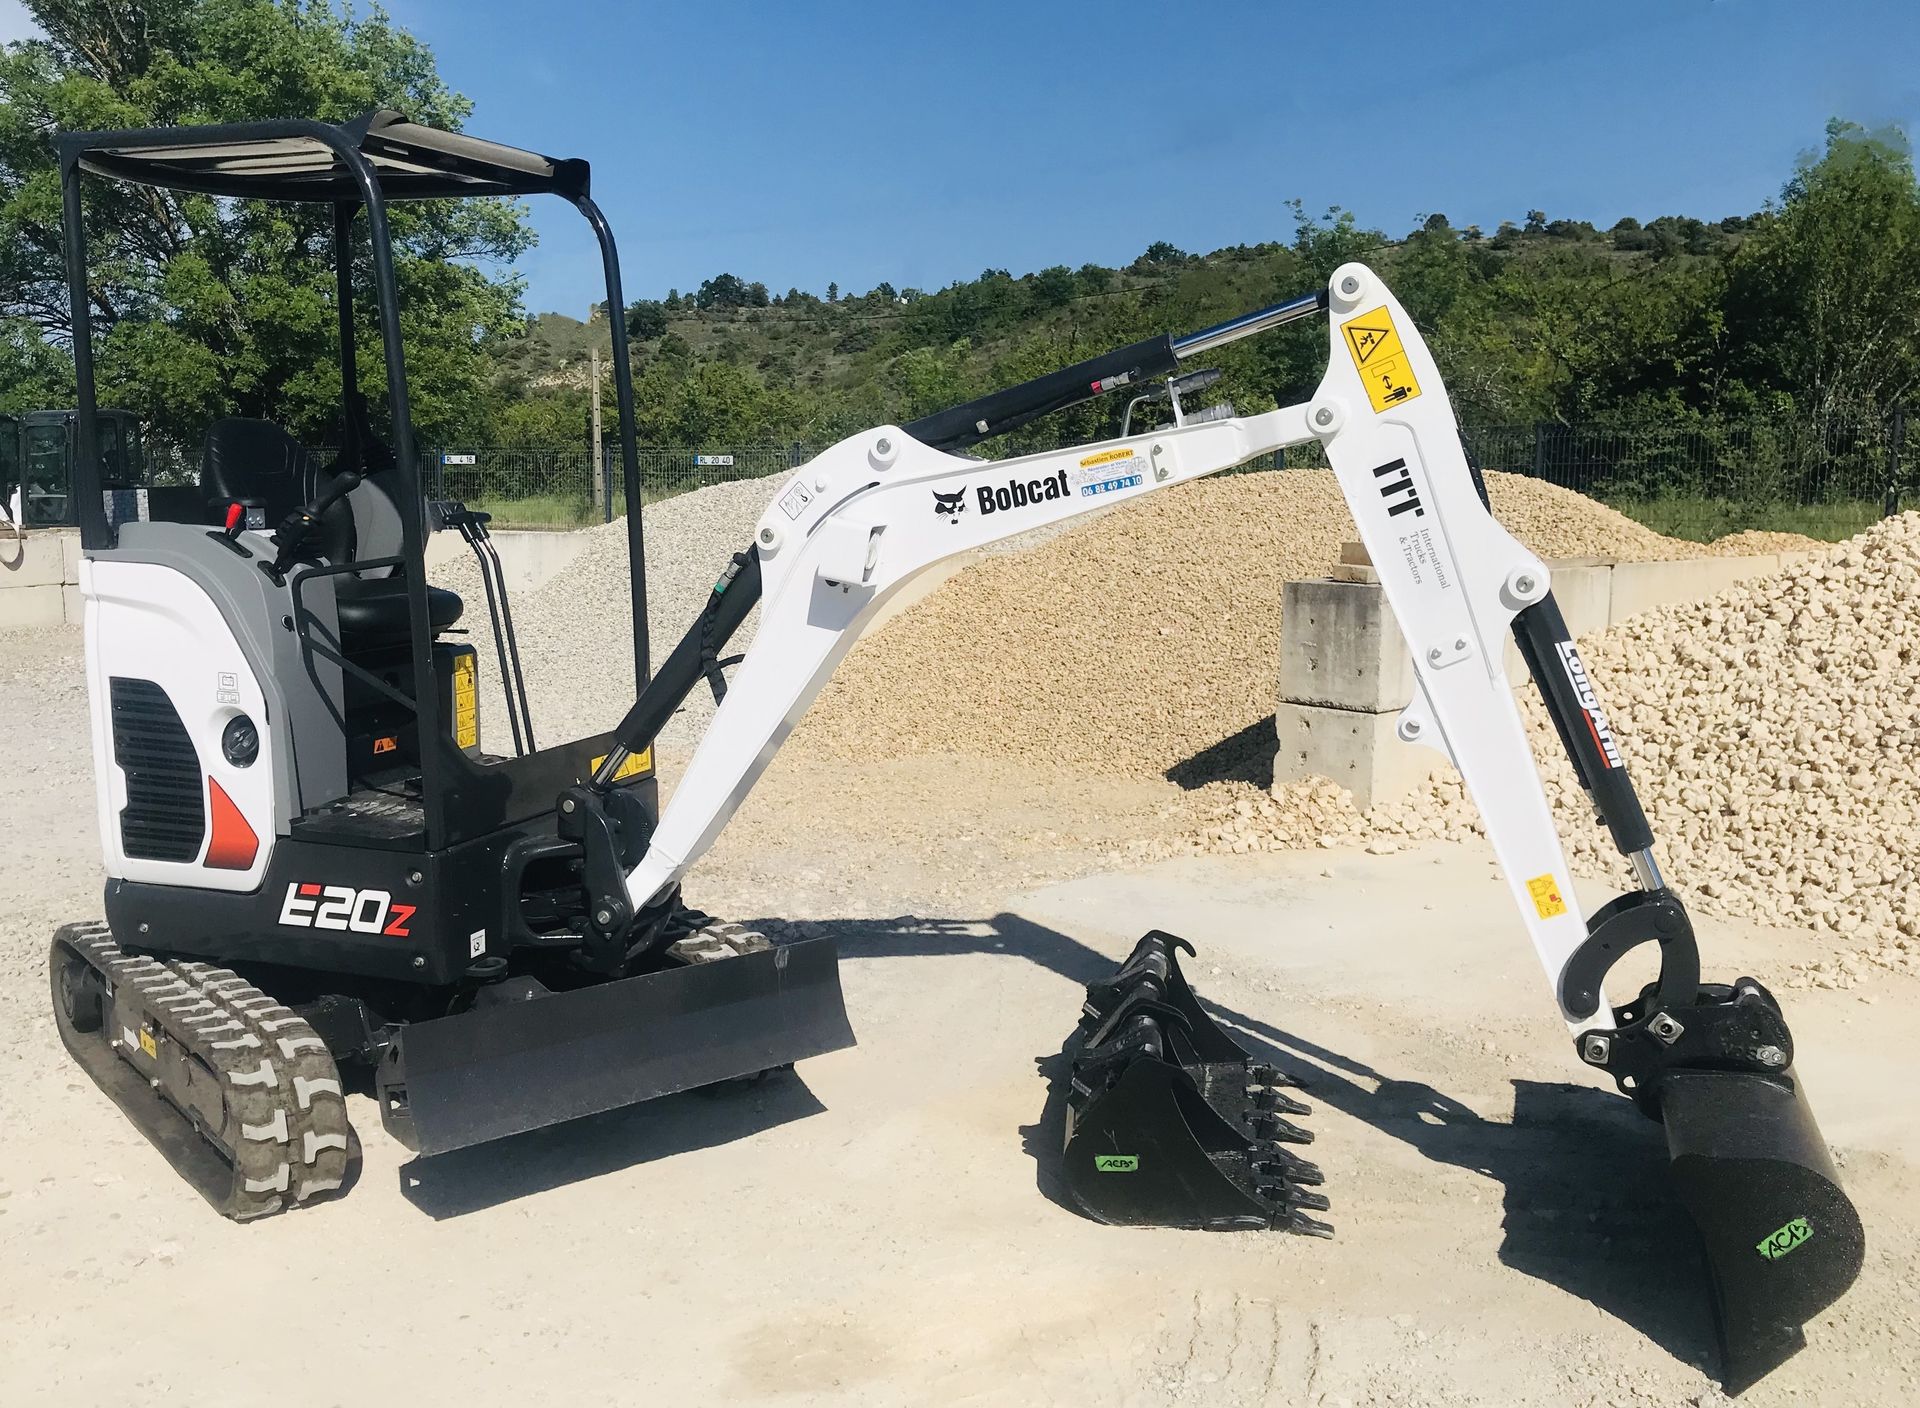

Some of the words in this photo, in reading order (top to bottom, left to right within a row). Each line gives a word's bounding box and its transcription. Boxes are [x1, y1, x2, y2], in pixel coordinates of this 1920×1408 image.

[699, 456, 708, 465] RL
[711, 456, 720, 464] 20
[1109, 449, 1134, 460] ROBERT
[977, 469, 1071, 515] Bobcat
[1082, 486, 1093, 496] 06
[1095, 484, 1106, 493] 82
[1108, 481, 1118, 491] 49
[1120, 479, 1130, 488] 74
[1132, 476, 1142, 485] 10
[1399, 536, 1406, 545] &
[1403, 544, 1423, 585] Tractors
[1410, 531, 1427, 565] Trucks
[1420, 527, 1451, 589] International
